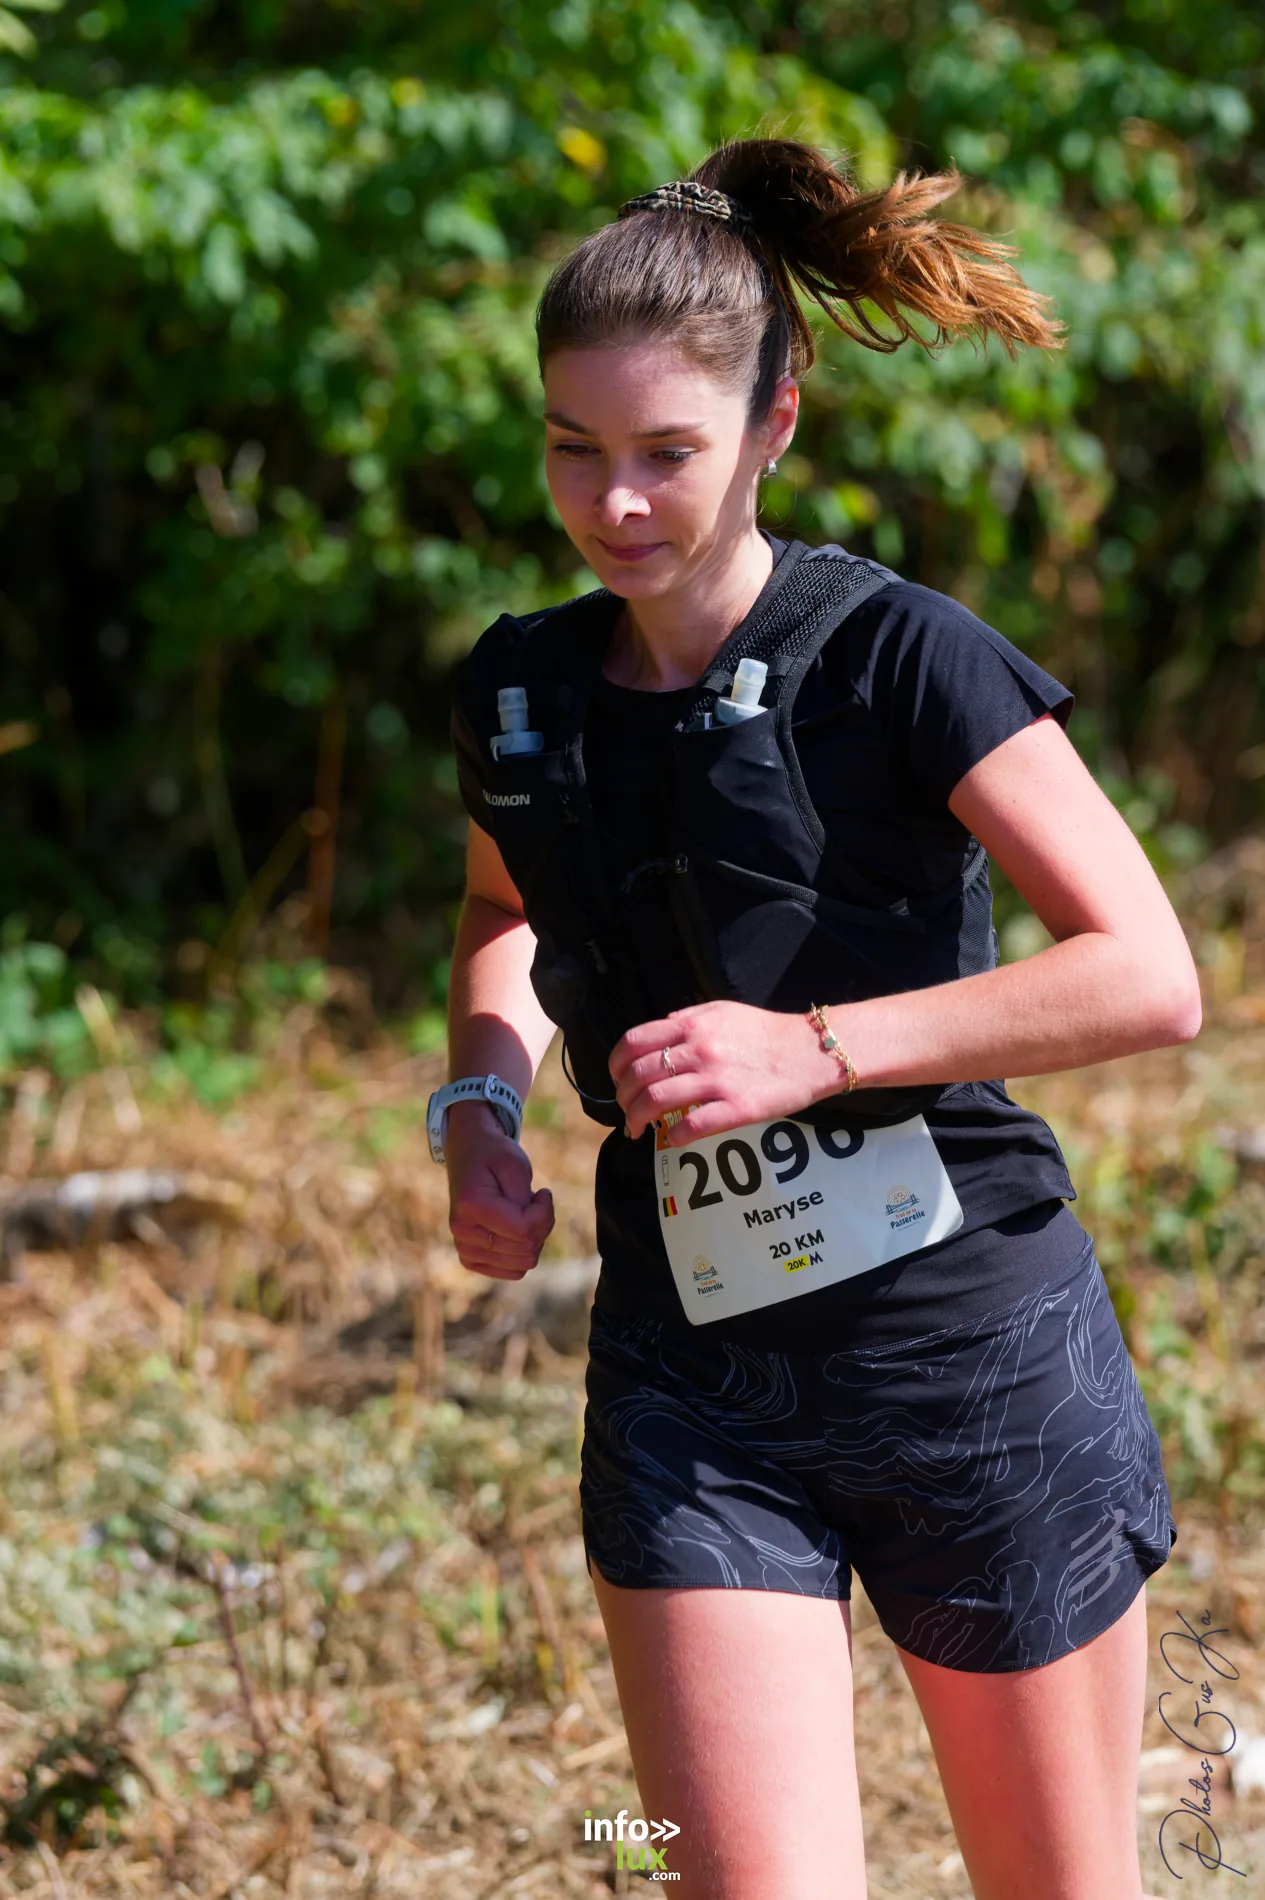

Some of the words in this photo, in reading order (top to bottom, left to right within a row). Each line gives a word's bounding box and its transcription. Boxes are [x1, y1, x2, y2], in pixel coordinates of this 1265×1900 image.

[743, 1191, 824, 1228] Maryse
[890, 1210, 926, 1229] Passerelle
[769, 1241, 791, 1259] 20
[794, 1229, 825, 1251] KM
[787, 1258, 806, 1271] 20K
